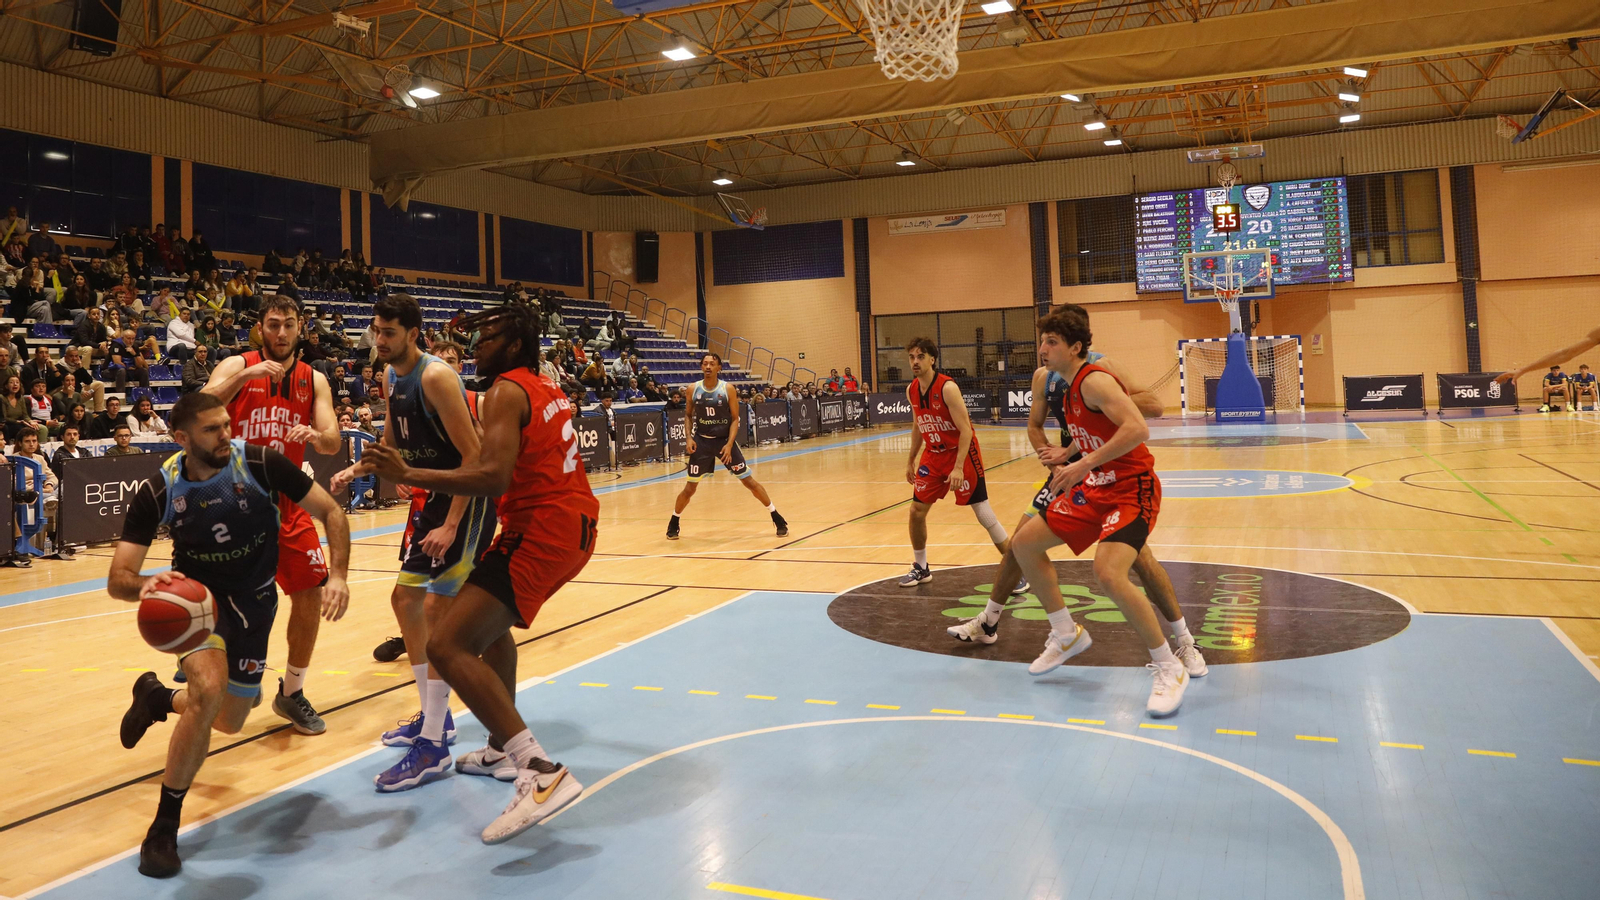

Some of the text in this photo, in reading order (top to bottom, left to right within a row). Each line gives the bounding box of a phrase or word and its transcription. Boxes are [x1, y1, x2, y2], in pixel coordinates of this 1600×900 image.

[1218, 214, 1236, 228] 3.5
[1247, 219, 1272, 234] 20
[1454, 389, 1480, 398] PSOE
[706, 407, 715, 416] 10
[876, 401, 912, 415] Socibus
[928, 433, 941, 443] 30
[690, 465, 699, 474] 10
[211, 522, 231, 543] 2
[307, 548, 324, 565] 20
